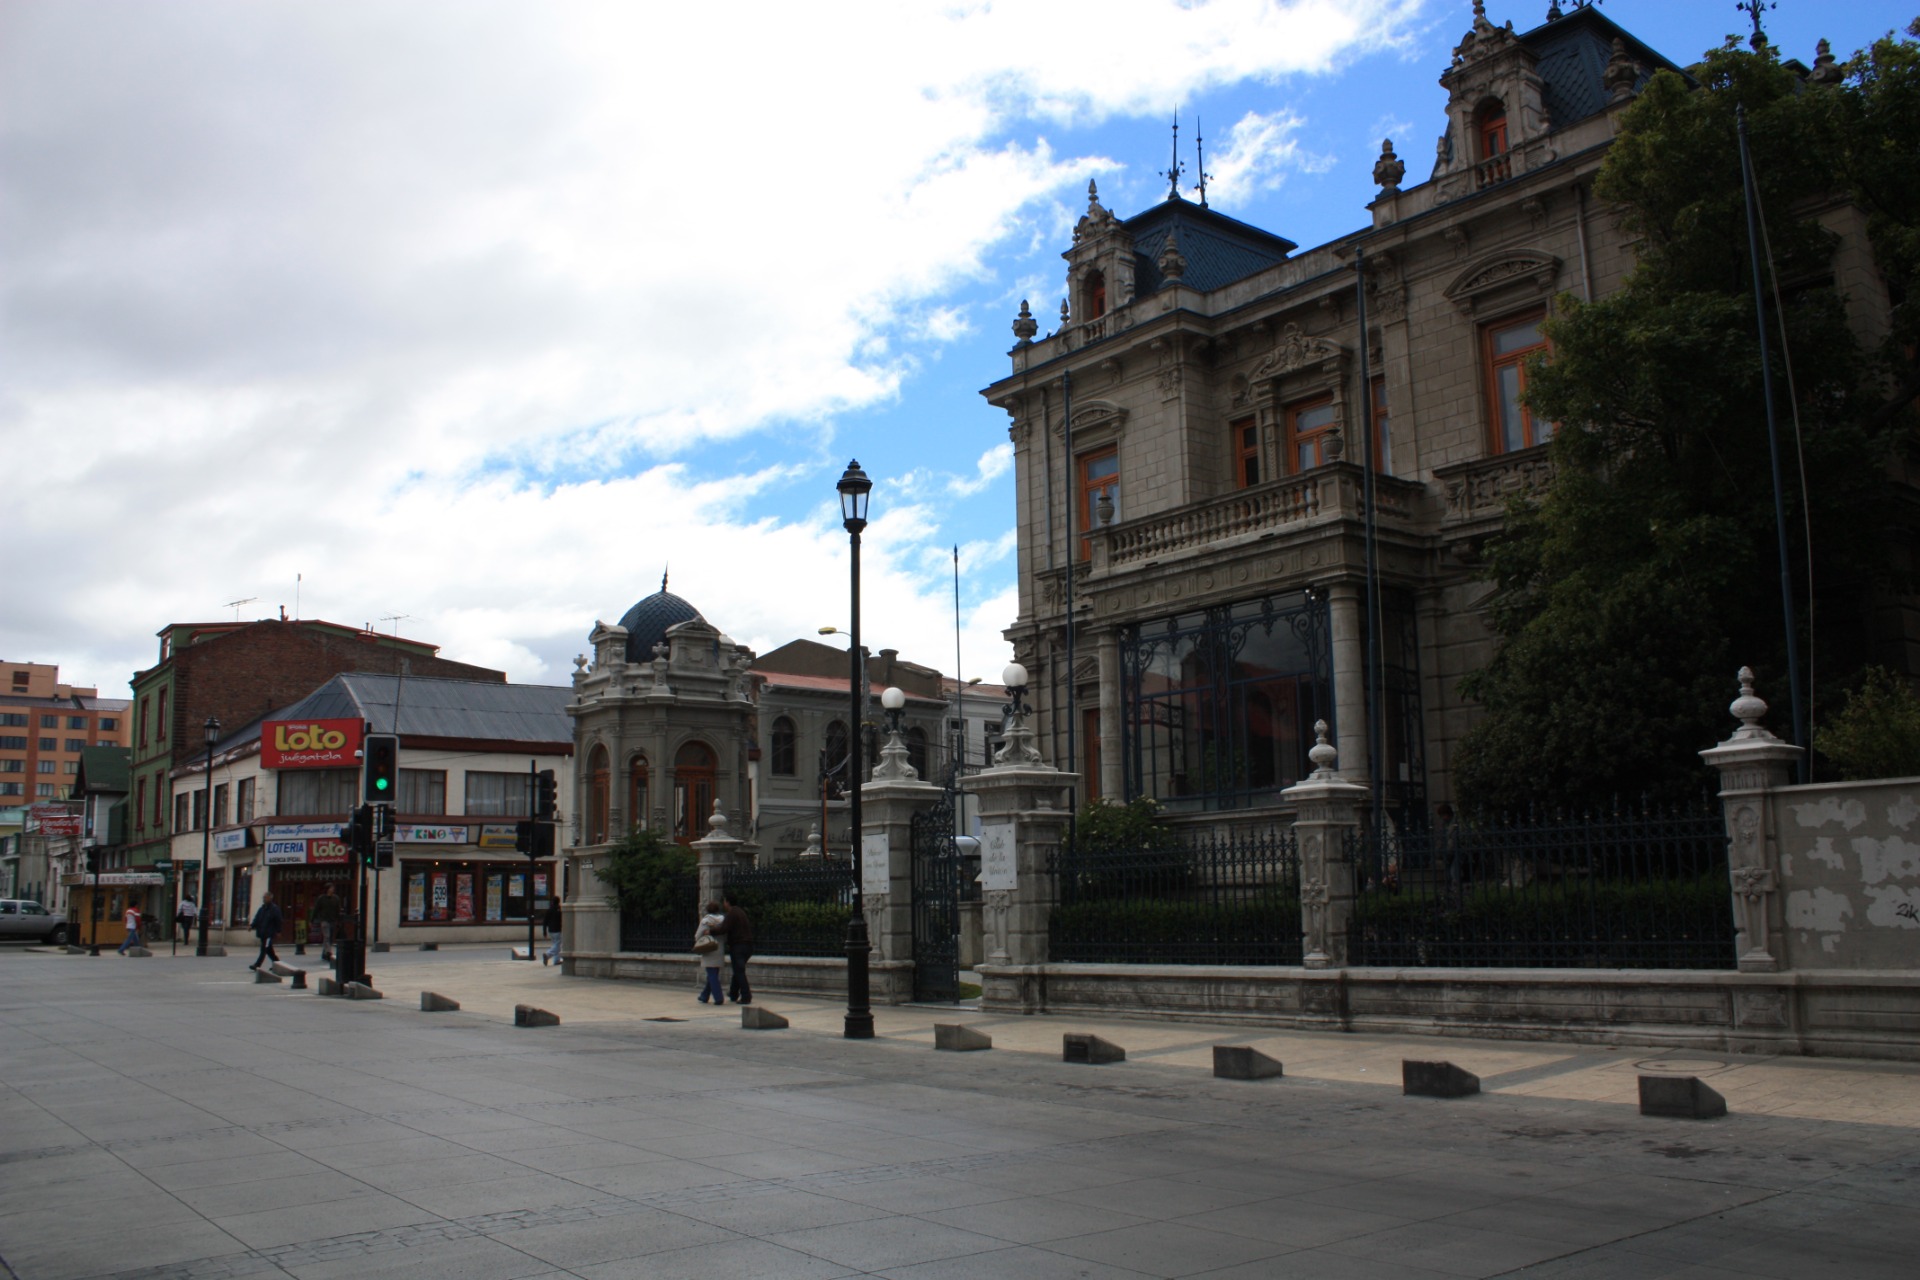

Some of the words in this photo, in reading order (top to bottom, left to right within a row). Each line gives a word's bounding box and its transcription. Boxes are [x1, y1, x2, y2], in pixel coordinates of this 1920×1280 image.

[275, 724, 346, 751] Loto
[267, 842, 304, 854] LOTERIA
[87, 875, 123, 883] LAVES
[434, 886, 447, 900] 539
